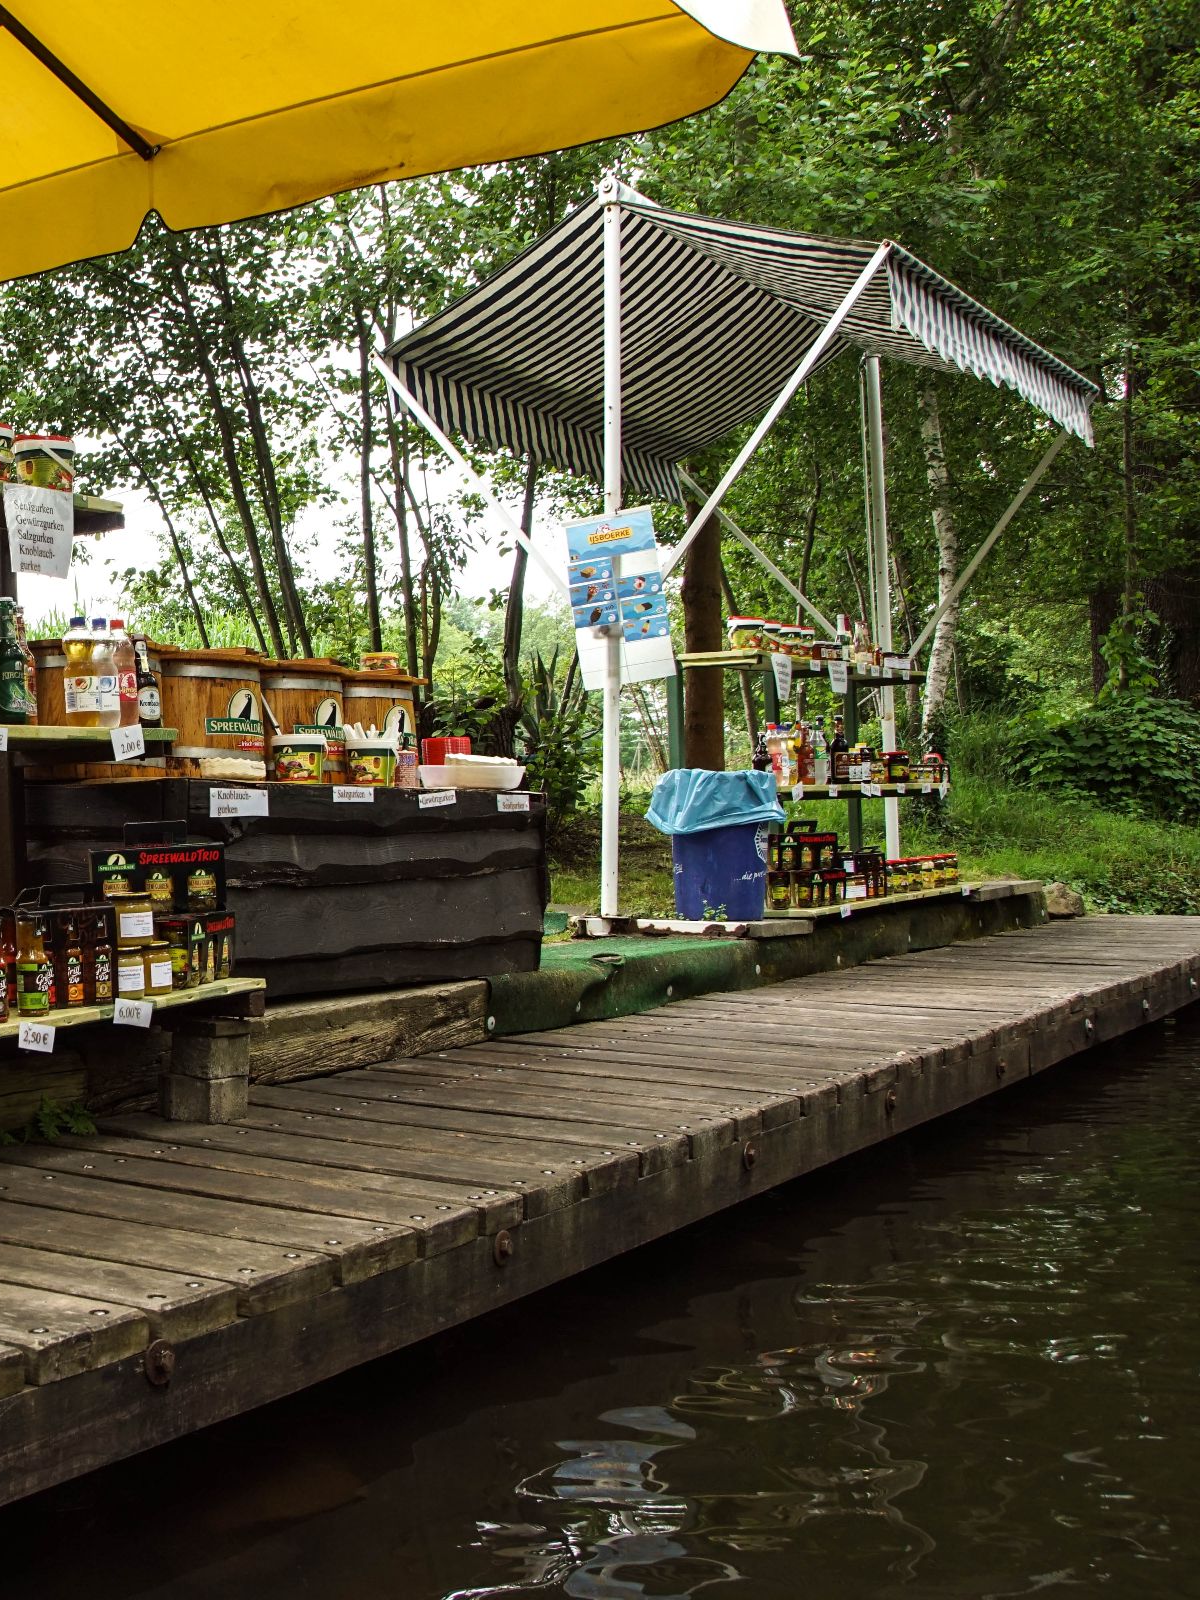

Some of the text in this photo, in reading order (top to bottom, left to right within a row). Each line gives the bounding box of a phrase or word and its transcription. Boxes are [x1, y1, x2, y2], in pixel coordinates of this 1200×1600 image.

[16, 515, 65, 533] Gewürzgurken
[18, 529, 54, 545] Salzgurken
[588, 527, 631, 545] IJSBOERKE
[120, 740, 141, 754] 2,00 €
[217, 790, 252, 801] Knoblauch-
[217, 804, 238, 816] gurken
[23, 1030, 49, 1045] 2,50 €
